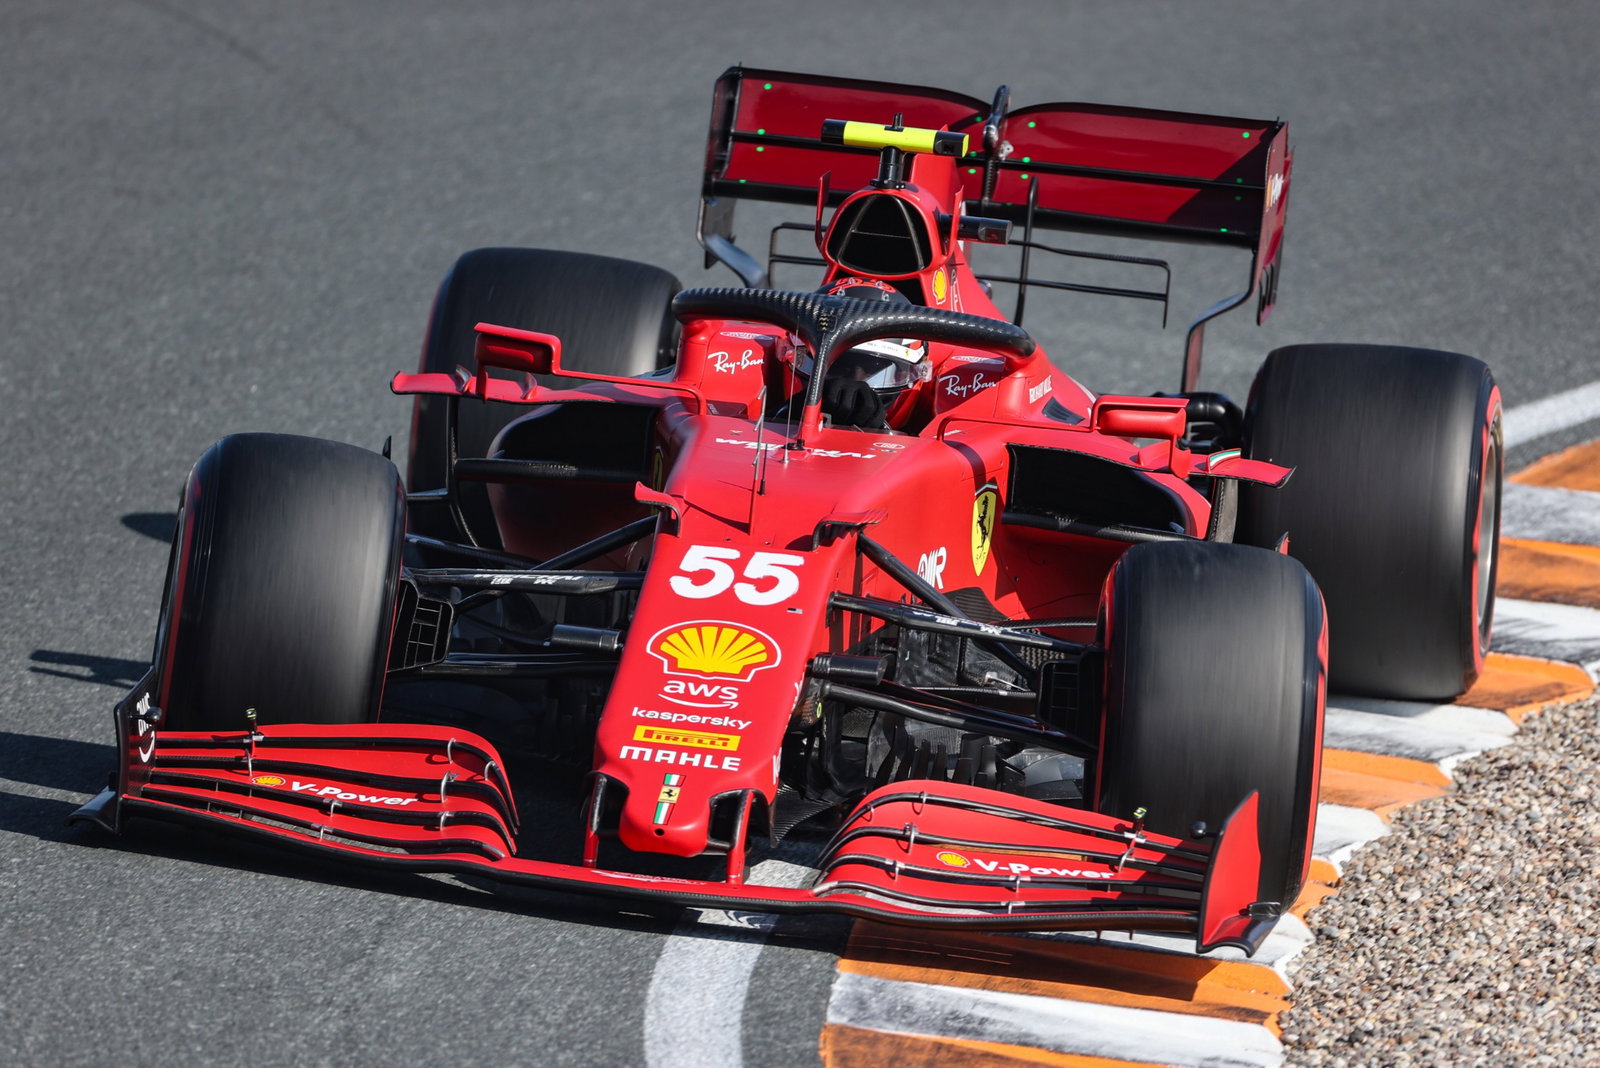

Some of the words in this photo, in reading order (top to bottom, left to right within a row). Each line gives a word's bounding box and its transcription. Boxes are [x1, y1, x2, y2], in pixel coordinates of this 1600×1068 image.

[707, 349, 764, 375] Ray-Ban
[939, 372, 997, 398] Ray-Ban
[669, 544, 805, 606] 55
[663, 680, 739, 701] aws
[631, 706, 752, 730] kaspersky
[643, 729, 730, 747] PIRELLI
[619, 745, 742, 771] MAHLE
[291, 780, 418, 806] V-Power
[973, 858, 1114, 880] V-Power
